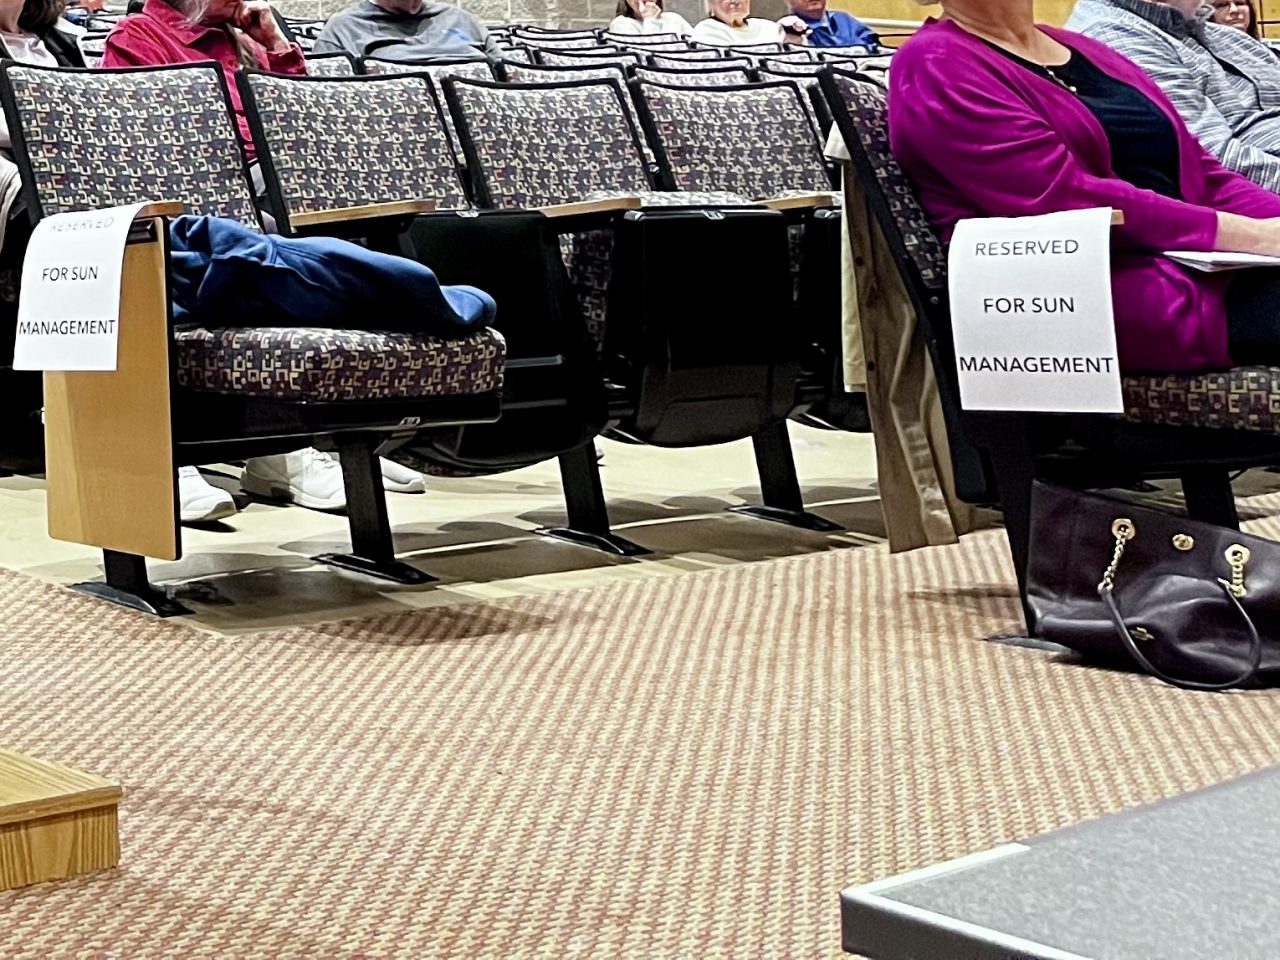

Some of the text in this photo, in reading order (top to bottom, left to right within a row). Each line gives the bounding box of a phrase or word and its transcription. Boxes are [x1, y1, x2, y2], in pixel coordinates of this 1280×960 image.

[51, 217, 114, 232] RESERVED
[975, 239, 1080, 257] RESERVED
[42, 266, 98, 281] FOR SUN
[983, 296, 1075, 314] FOR SUN
[19, 320, 115, 335] MANAGEMENT
[960, 357, 1113, 373] MANAGEMENT
